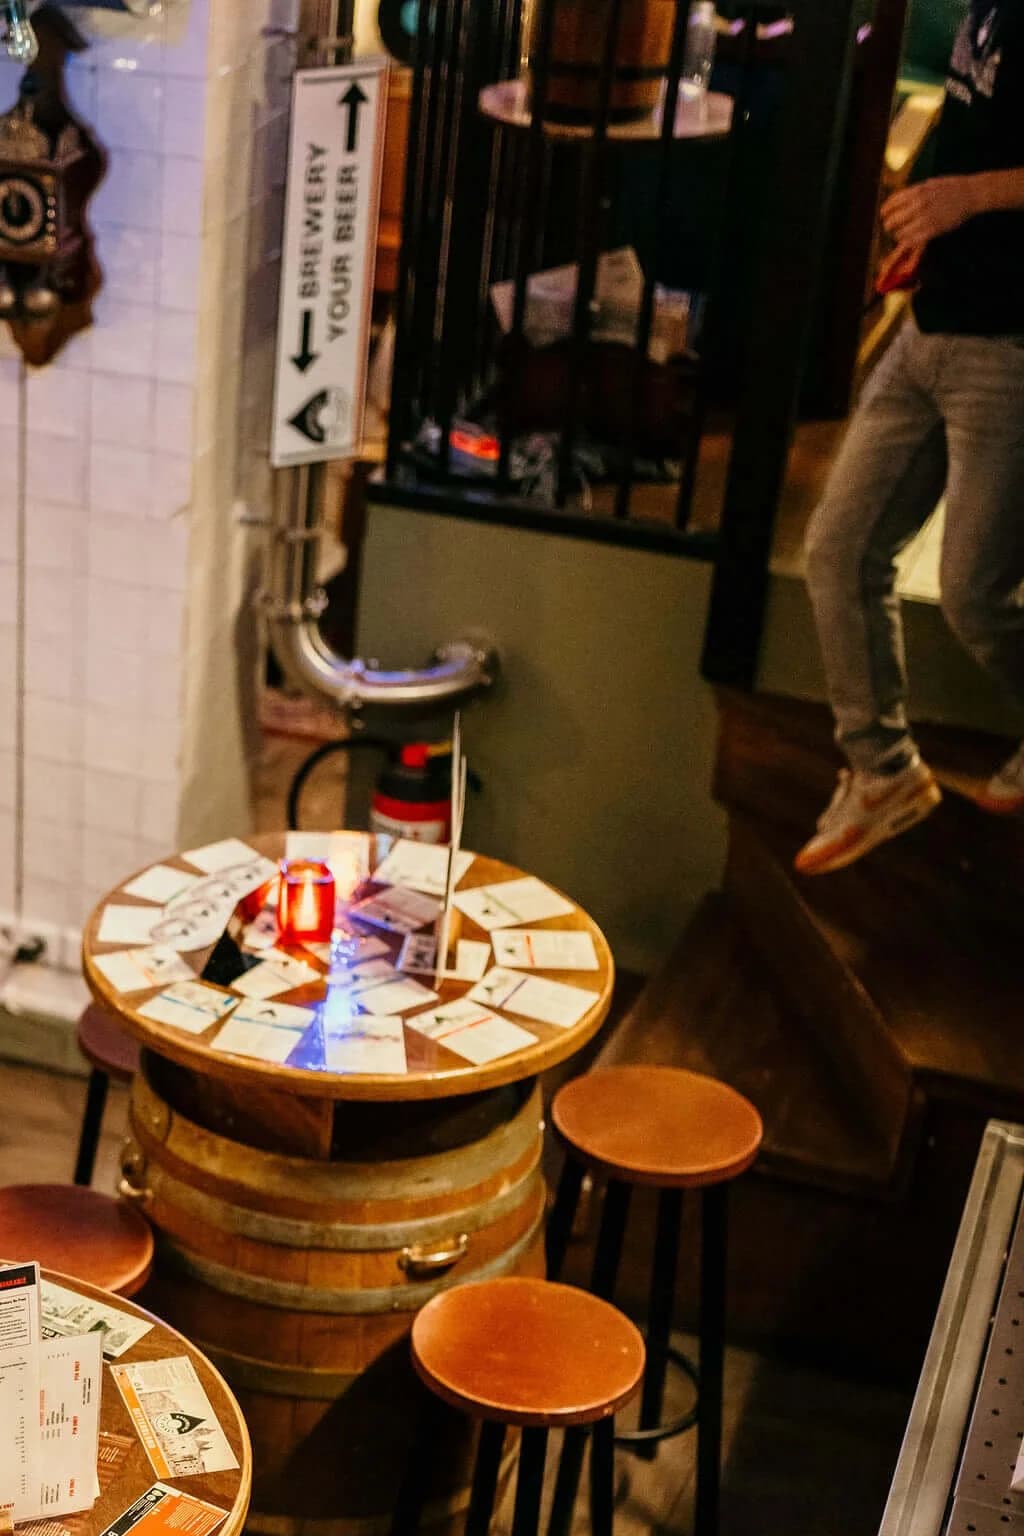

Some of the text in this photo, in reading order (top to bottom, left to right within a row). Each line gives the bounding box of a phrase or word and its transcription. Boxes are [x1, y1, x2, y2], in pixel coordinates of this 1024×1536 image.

[300, 143, 327, 300] BREWERY
[328, 162, 360, 343] YOUR BEER
